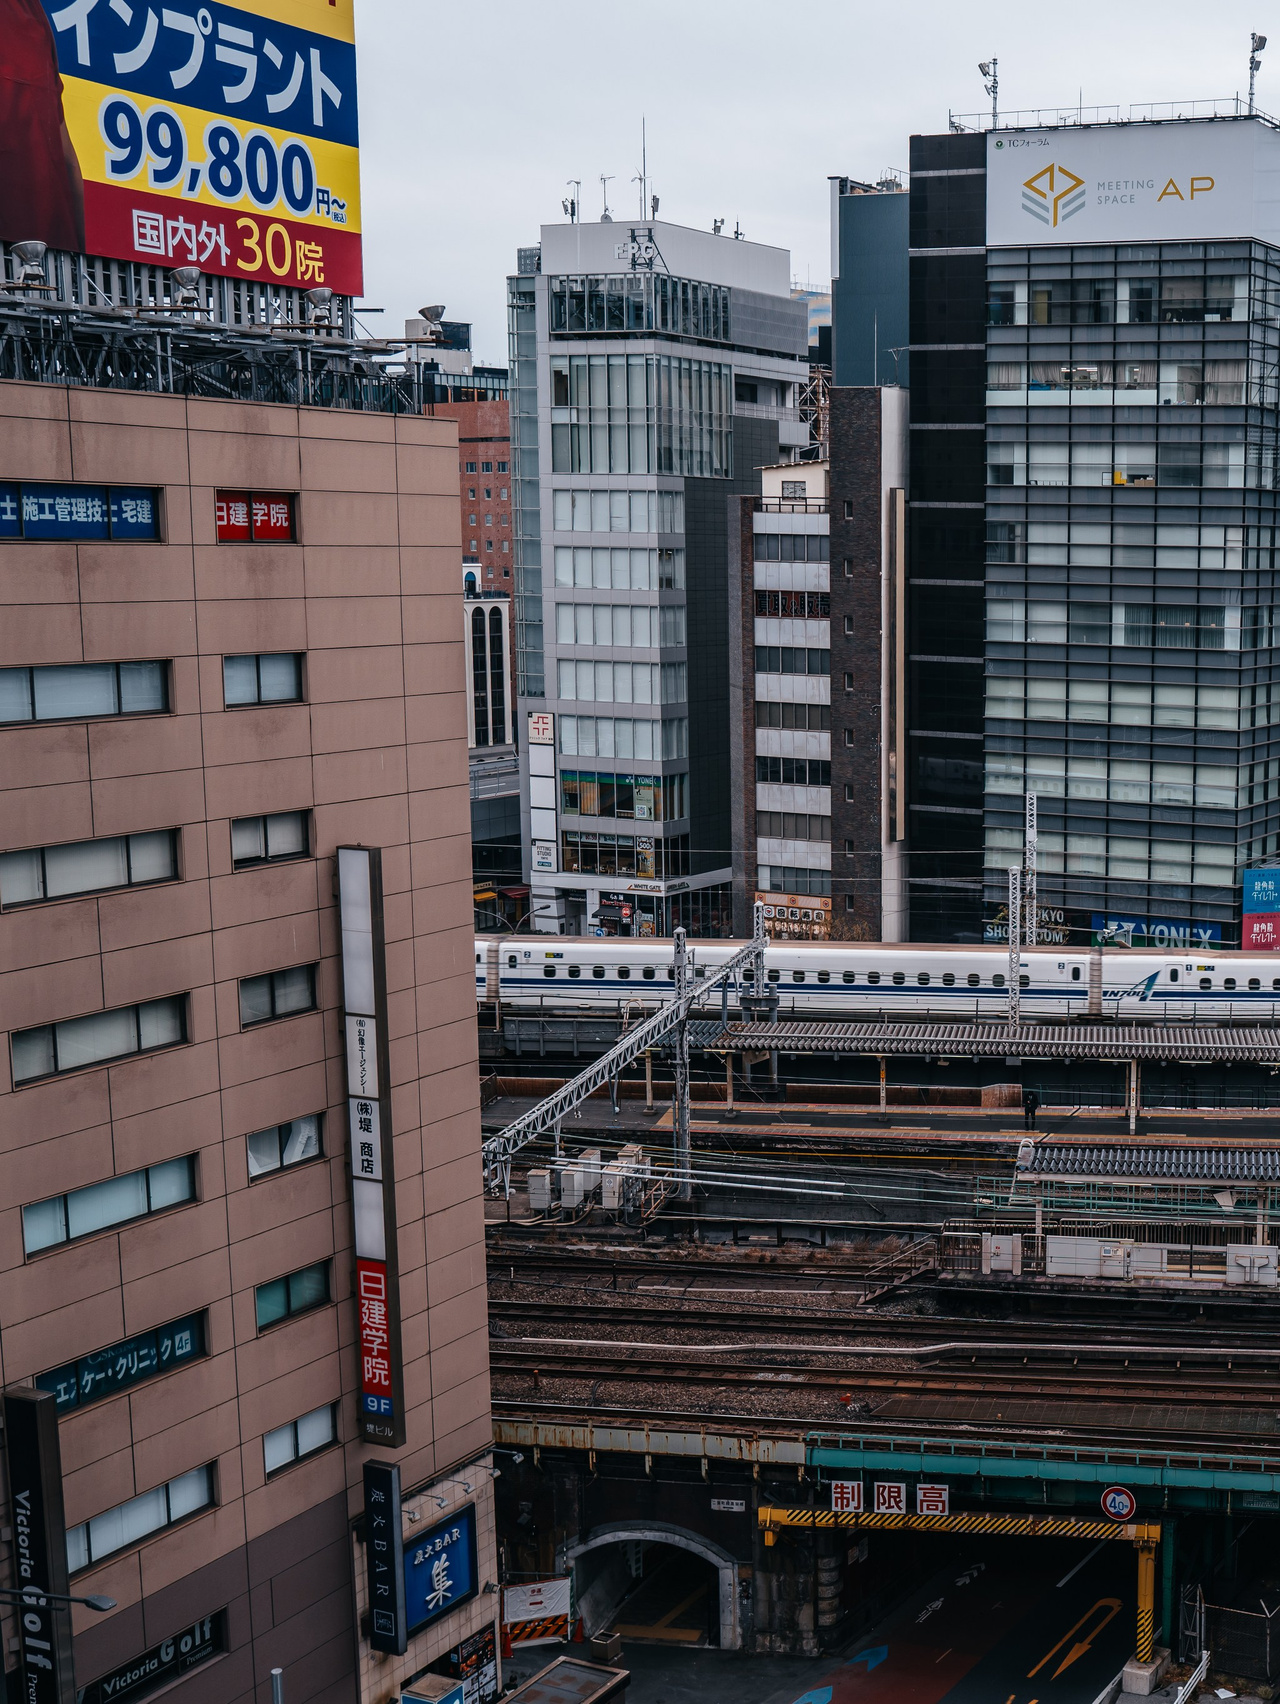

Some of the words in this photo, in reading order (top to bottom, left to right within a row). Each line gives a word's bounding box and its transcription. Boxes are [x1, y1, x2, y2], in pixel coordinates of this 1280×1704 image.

[52, 0, 343, 128] インプラント
[1007, 138, 1050, 148] TCフォーラム
[1097, 179, 1155, 191] MEETING
[1157, 176, 1215, 202] AP
[1097, 194, 1136, 205] SPACE
[132, 209, 326, 284] 国内外30院
[22, 495, 118, 523] 施工管理技士
[121, 499, 152, 524] 宅建
[217, 502, 289, 527] 日建学院
[1141, 923, 1213, 949] YONEX
[359, 1270, 390, 1386] 日建学院
[176, 1335, 190, 1351] 4F
[367, 1397, 390, 1413] 9F
[833, 1483, 946, 1514] 制限高
[15, 1490, 35, 1578] Victoria
[22, 1585, 53, 1670] Golf
[103, 1657, 159, 1696] Victoria
[160, 1616, 212, 1663] Golf
[186, 1645, 213, 1666] Premium
